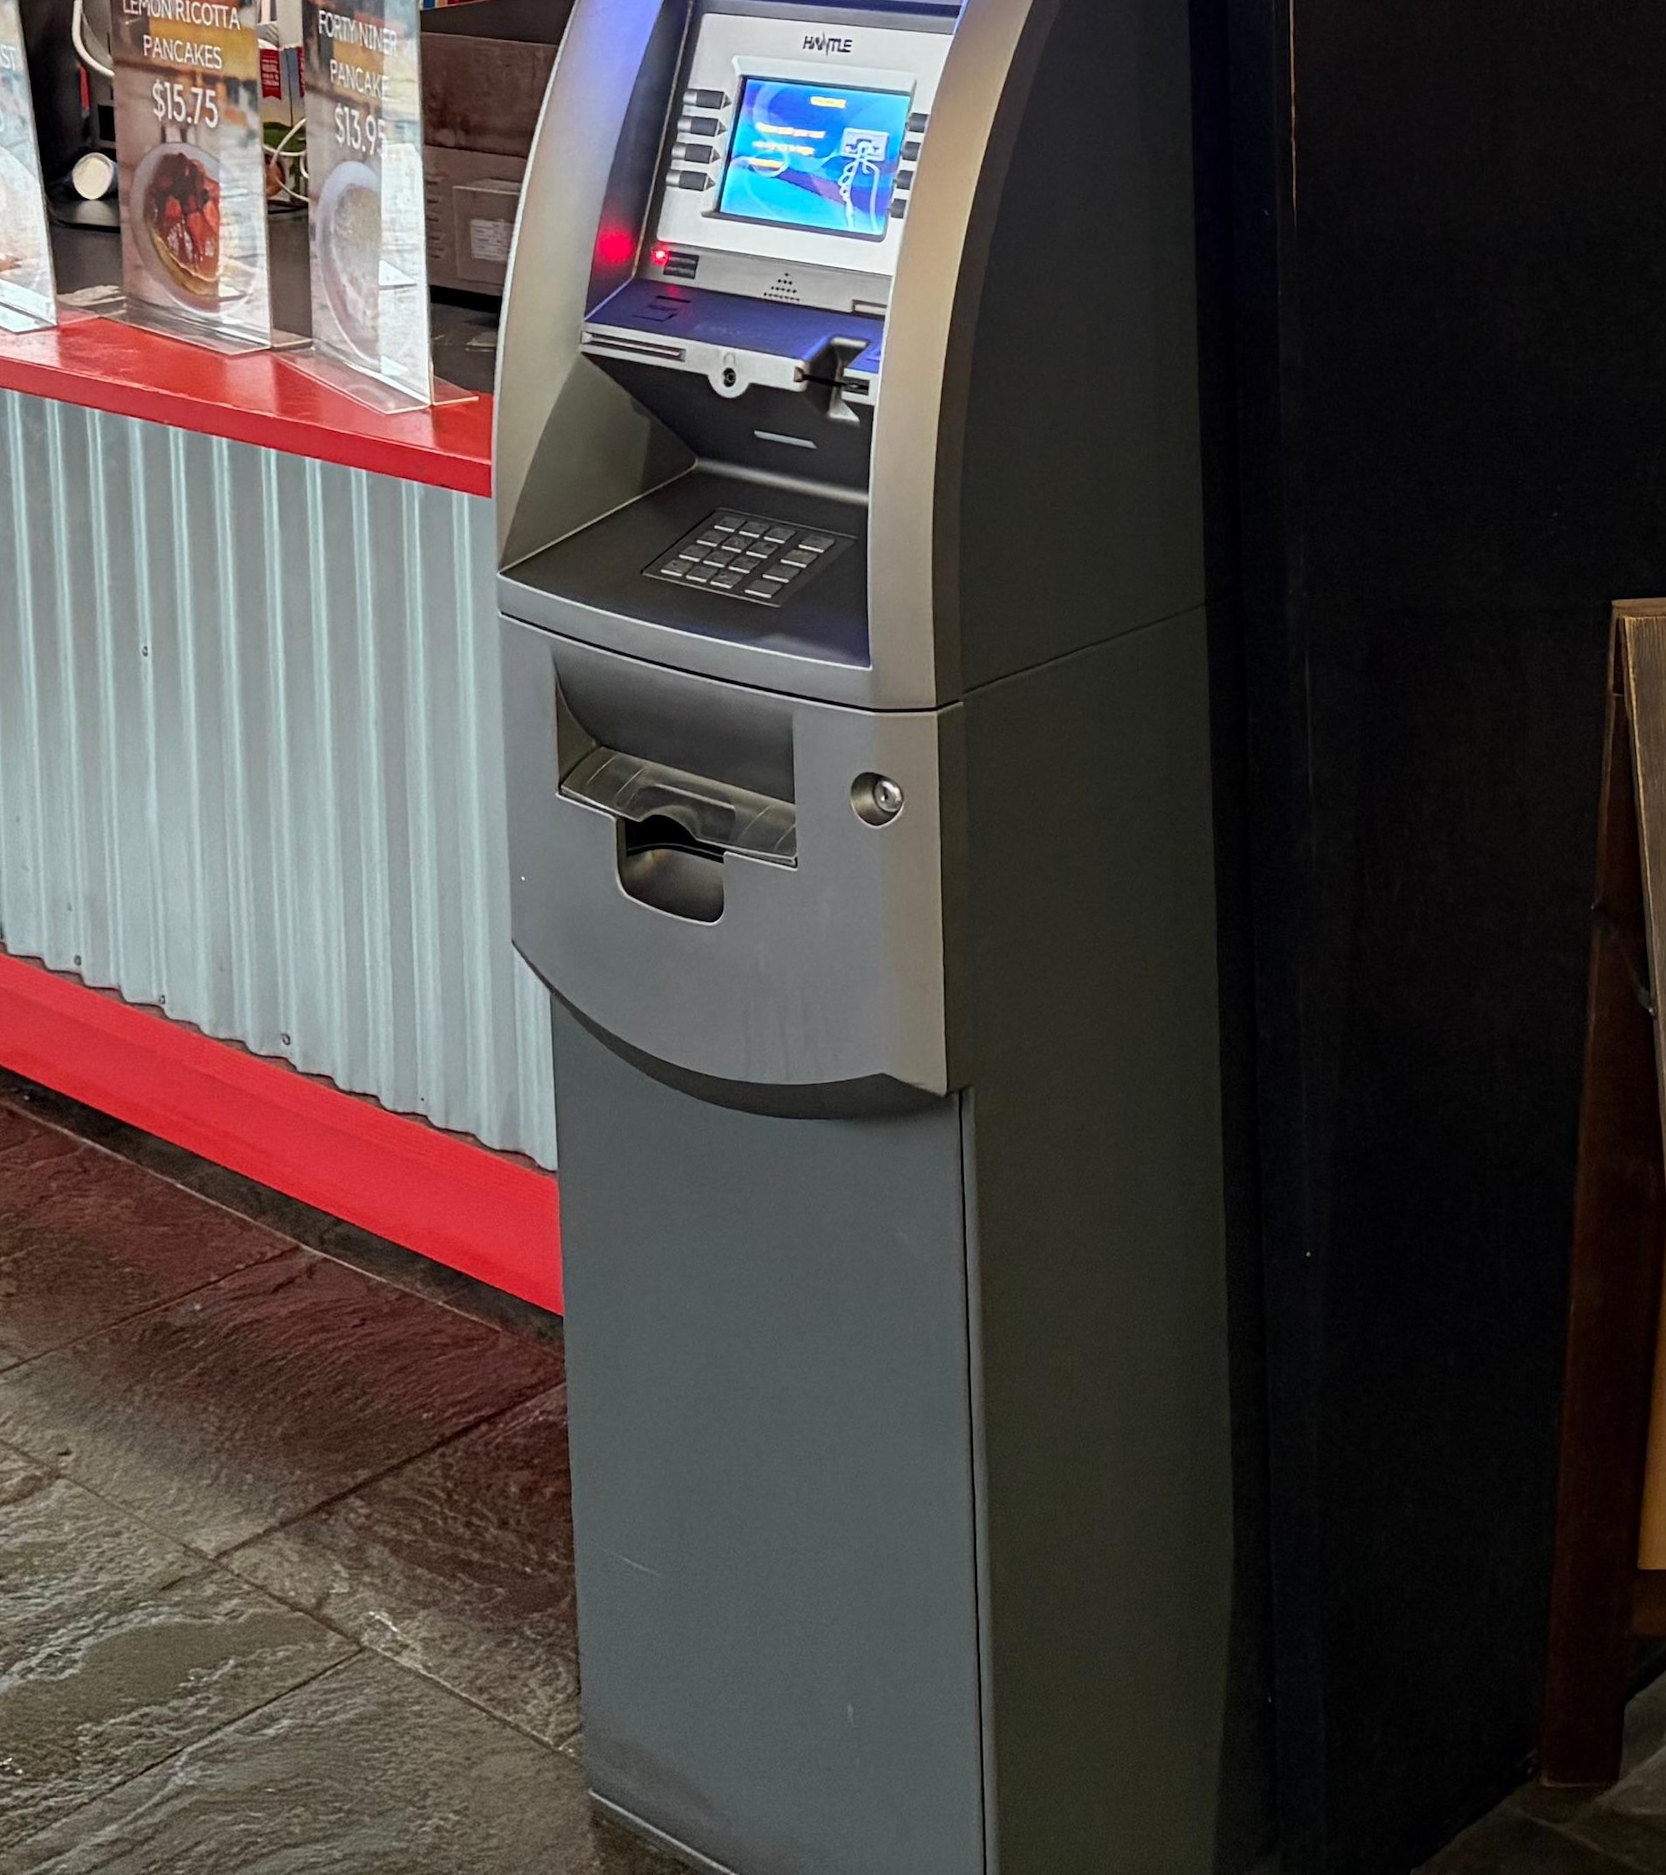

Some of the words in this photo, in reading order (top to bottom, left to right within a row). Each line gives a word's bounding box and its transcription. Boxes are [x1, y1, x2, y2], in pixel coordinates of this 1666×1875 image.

[143, 35, 222, 70] PANCAKES
[319, 9, 358, 43] FORTY
[359, 18, 397, 55] NINER
[330, 59, 391, 99] PANCAKE
[152, 79, 219, 128] $15.75
[334, 103, 387, 155] $13.95
